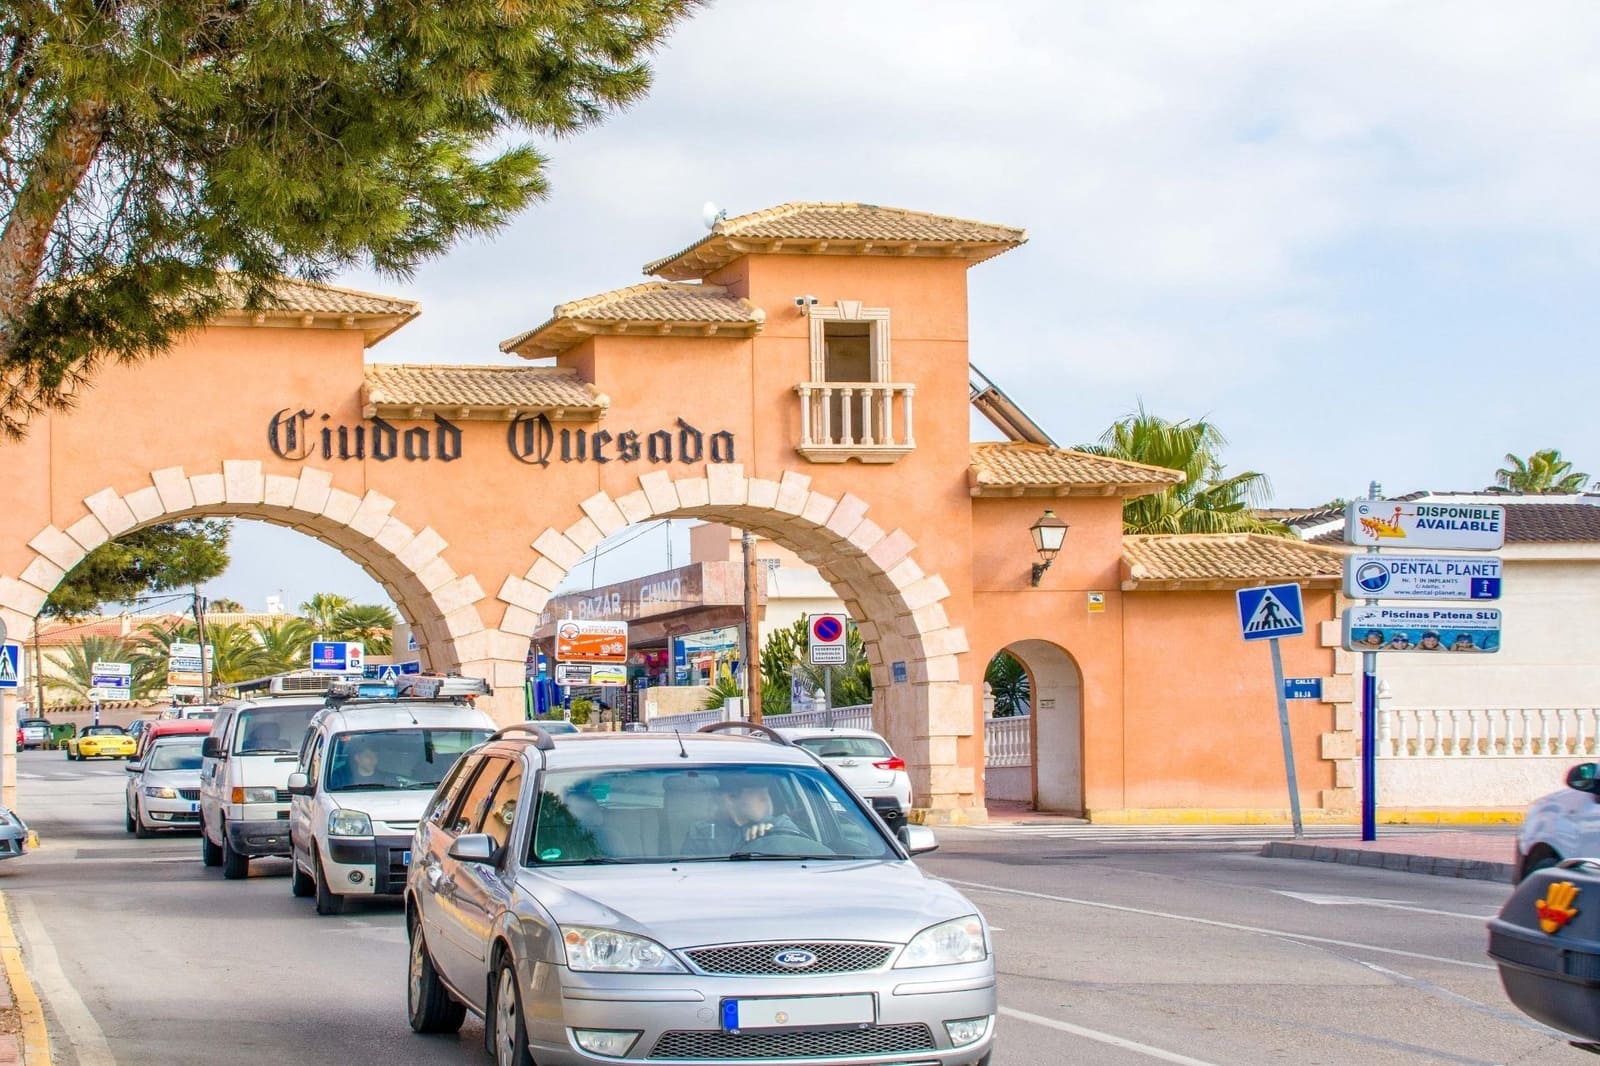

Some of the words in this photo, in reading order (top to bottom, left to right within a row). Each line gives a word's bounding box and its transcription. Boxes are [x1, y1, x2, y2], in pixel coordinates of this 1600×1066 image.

[268, 407, 464, 463] Ciudad
[507, 411, 735, 469] Quesada
[1416, 506, 1500, 520] DISPONIBLE
[1416, 518, 1499, 532] AVAILABLE
[1391, 562, 1442, 576] DENTAL
[1446, 563, 1499, 576] PLANET
[578, 592, 622, 619] BAZAR
[640, 578, 682, 605] CHINO
[1381, 610, 1430, 619] Piscinas
[1432, 611, 1473, 619] Patena
[1475, 611, 1498, 620] SLU
[784, 953, 806, 963] Ford
